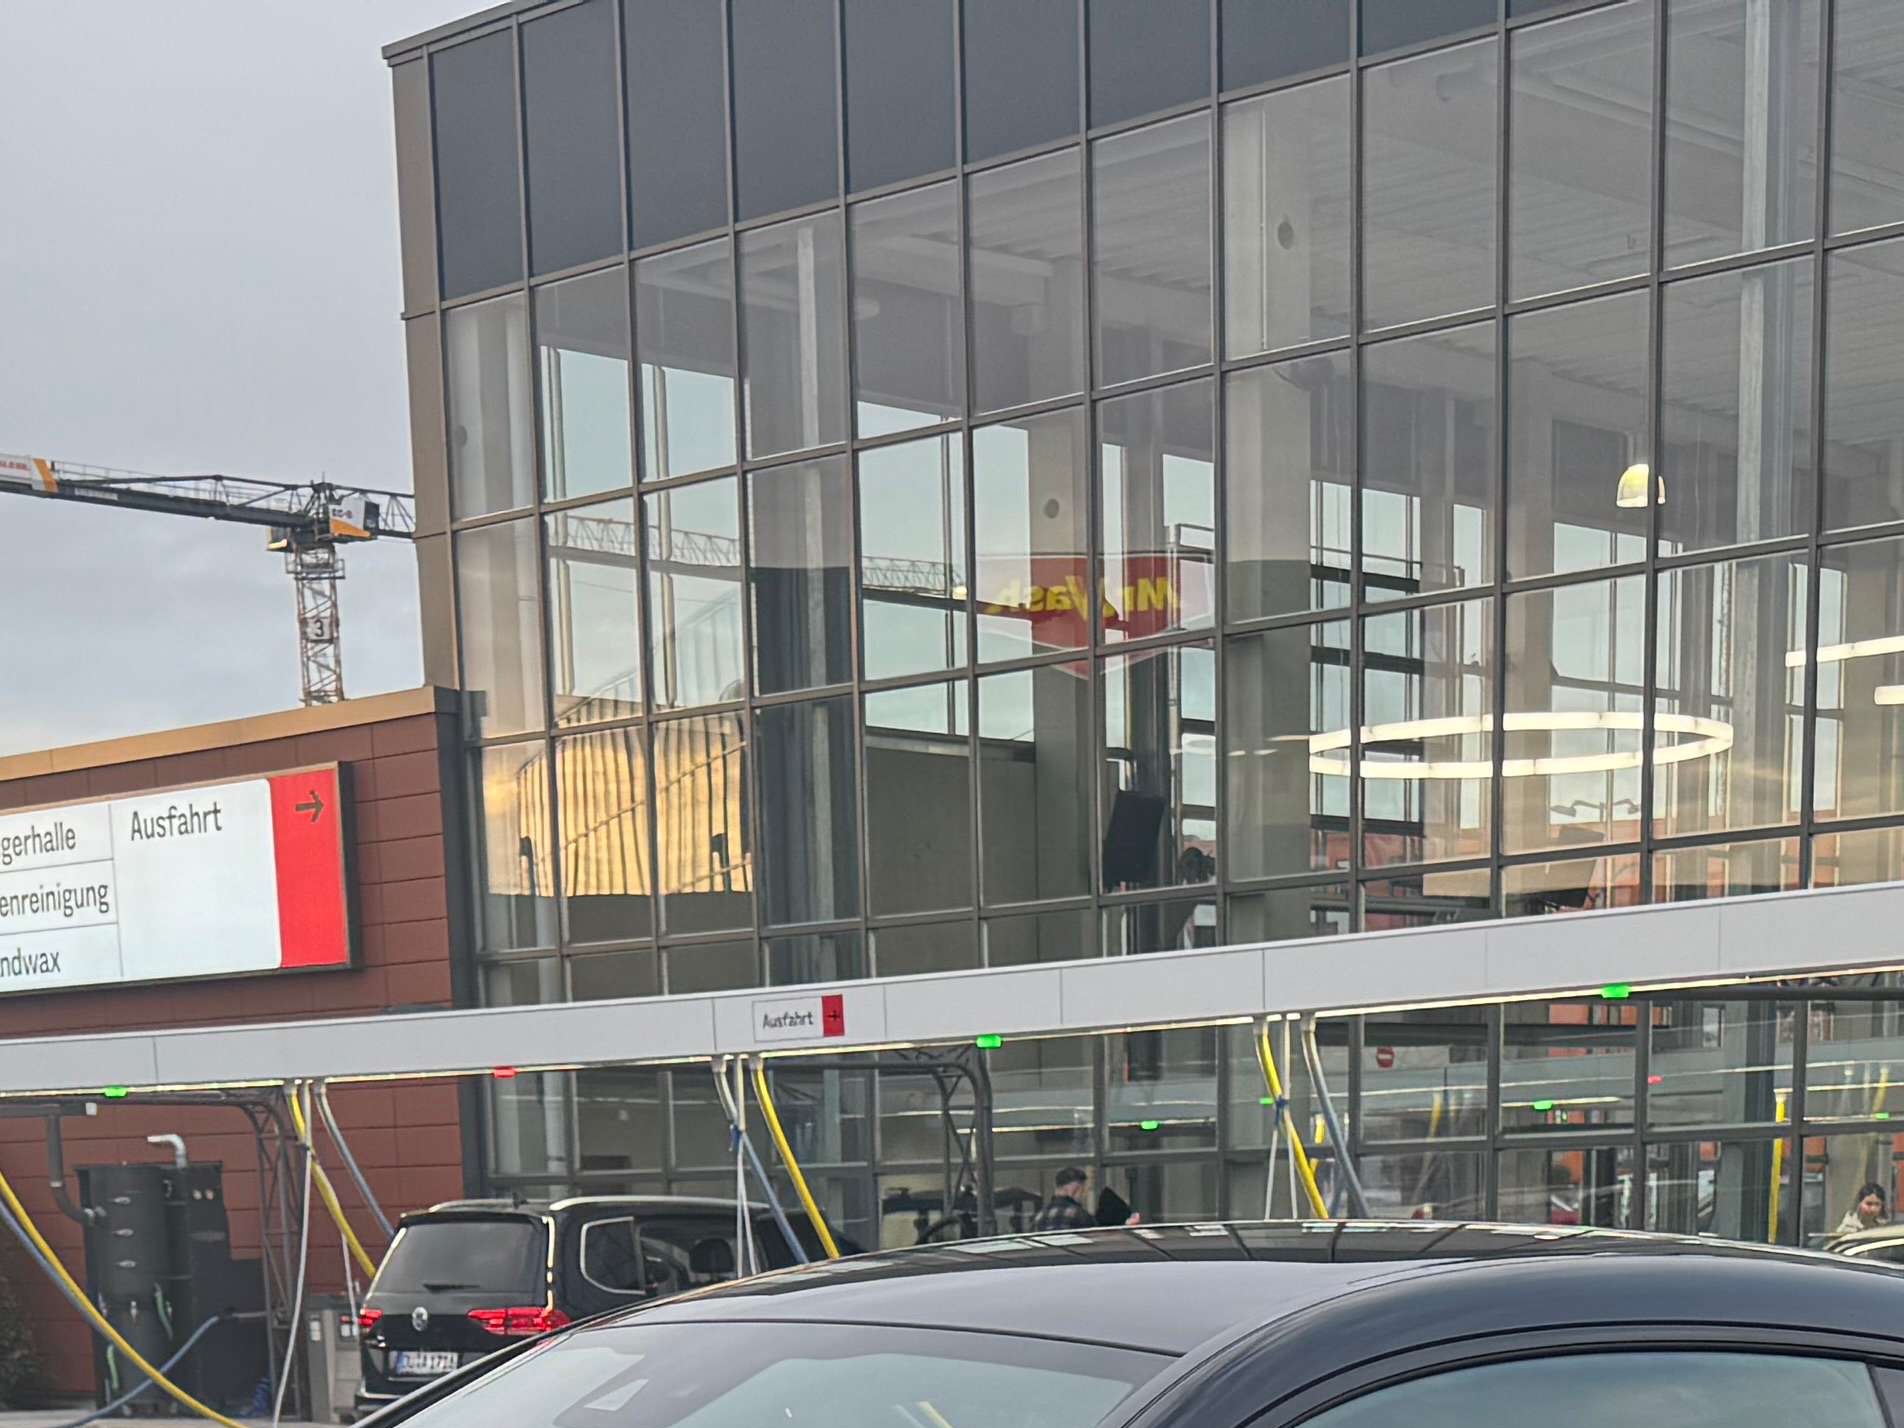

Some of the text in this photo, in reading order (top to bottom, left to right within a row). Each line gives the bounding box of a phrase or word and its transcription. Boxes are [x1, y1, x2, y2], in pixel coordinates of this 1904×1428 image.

[313, 619, 325, 638] 3
[130, 801, 222, 841] Ausfahrt
[762, 1011, 814, 1030] Ausfahrt
